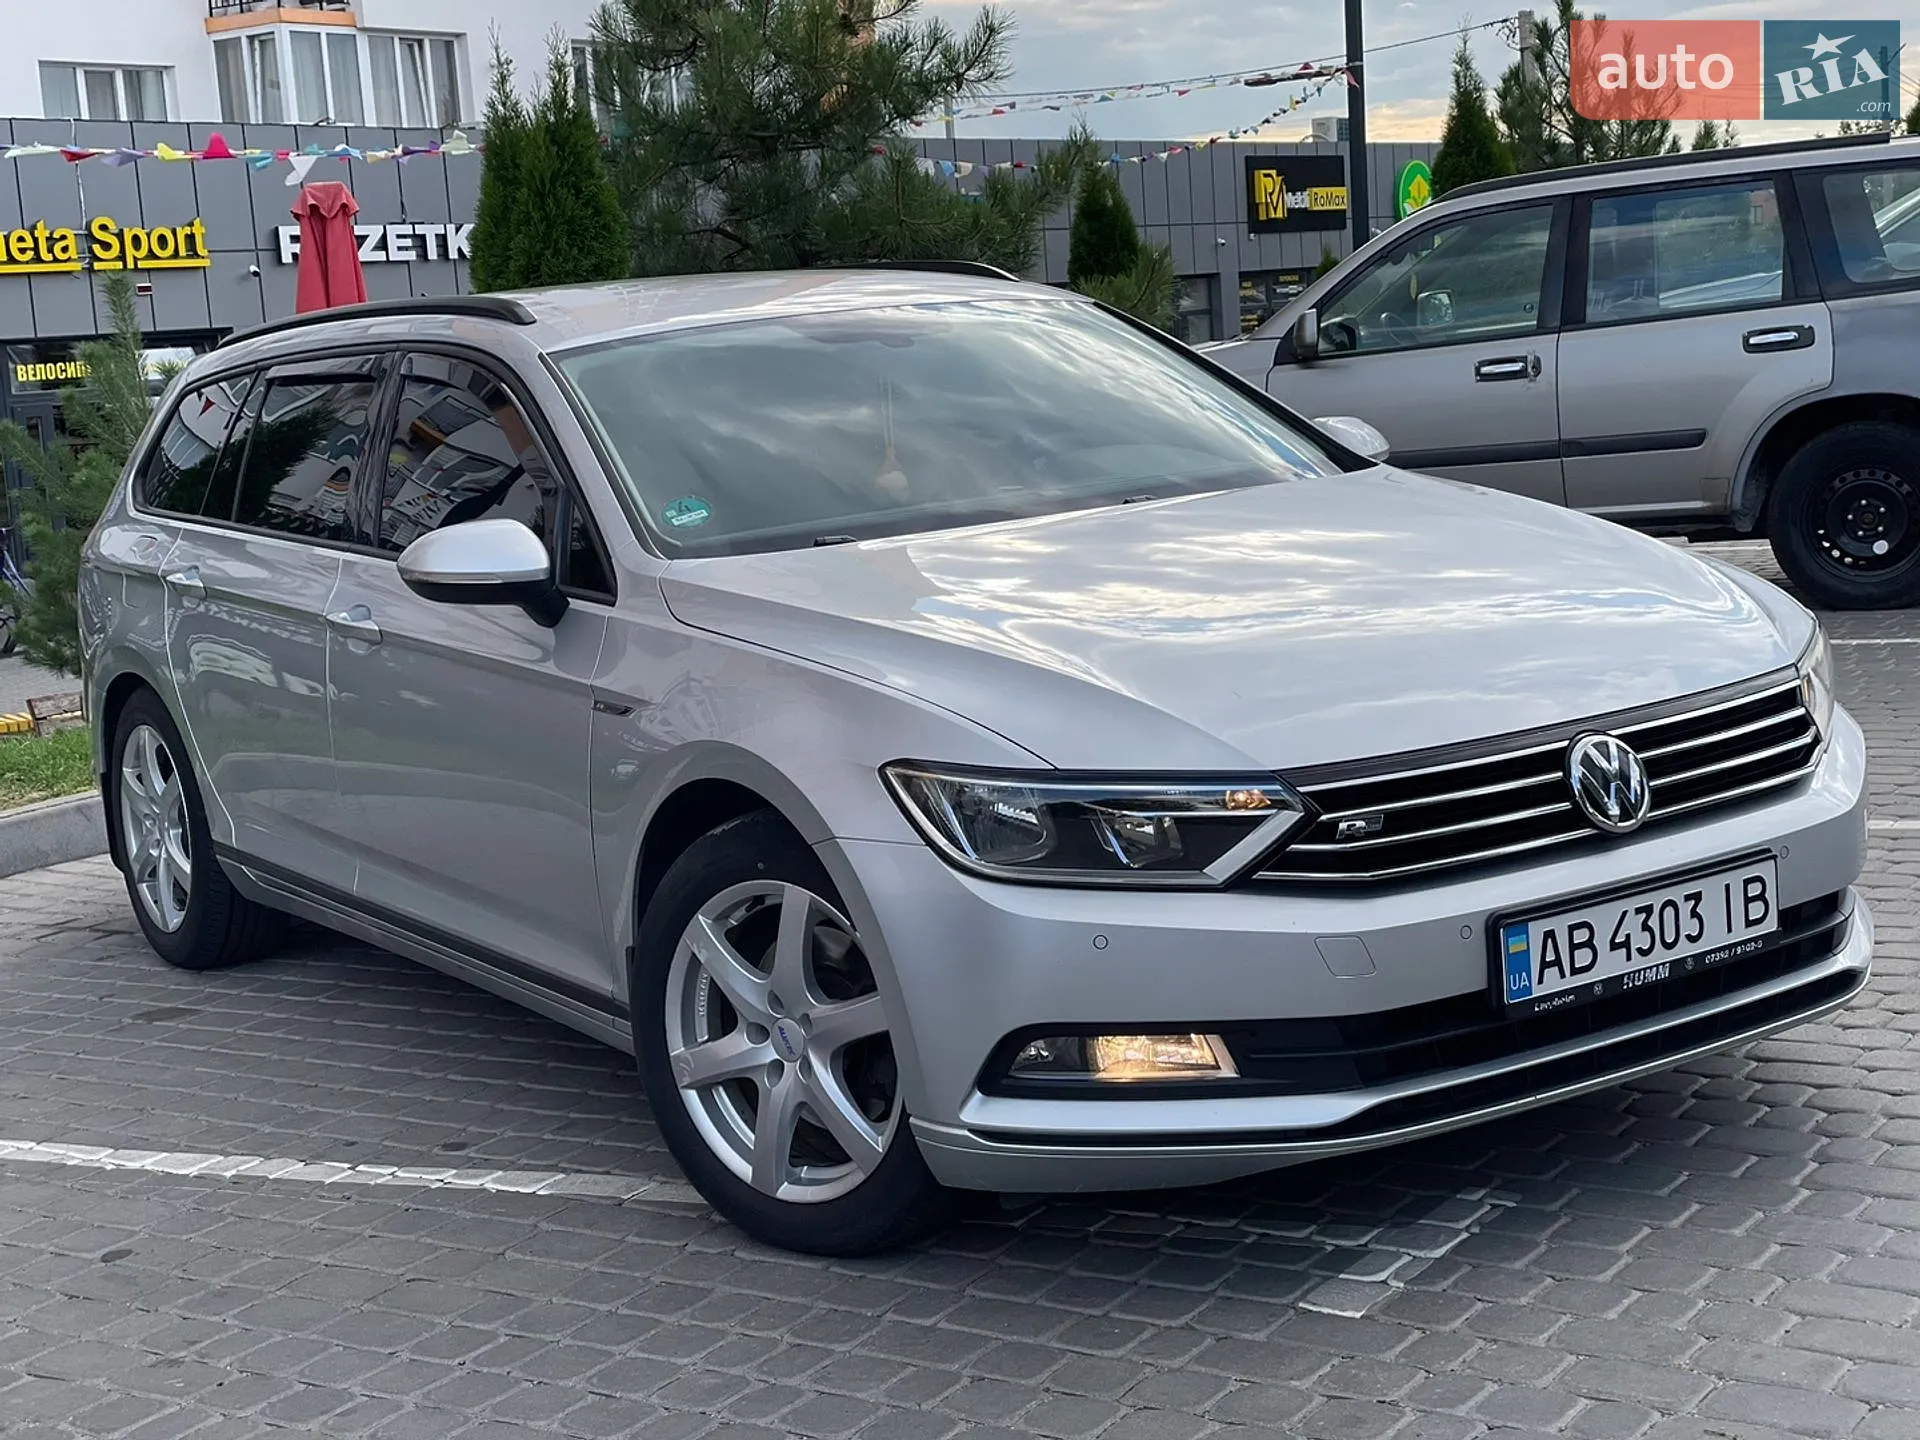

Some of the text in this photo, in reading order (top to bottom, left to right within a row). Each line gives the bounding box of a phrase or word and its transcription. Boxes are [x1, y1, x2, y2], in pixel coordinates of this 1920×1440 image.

[1313, 191, 1345, 208] RoMax
[91, 216, 209, 269] Sport
[278, 223, 474, 264] RZETK
[1537, 874, 1770, 986] AB 4303 IB
[1510, 972, 1530, 991] UA
